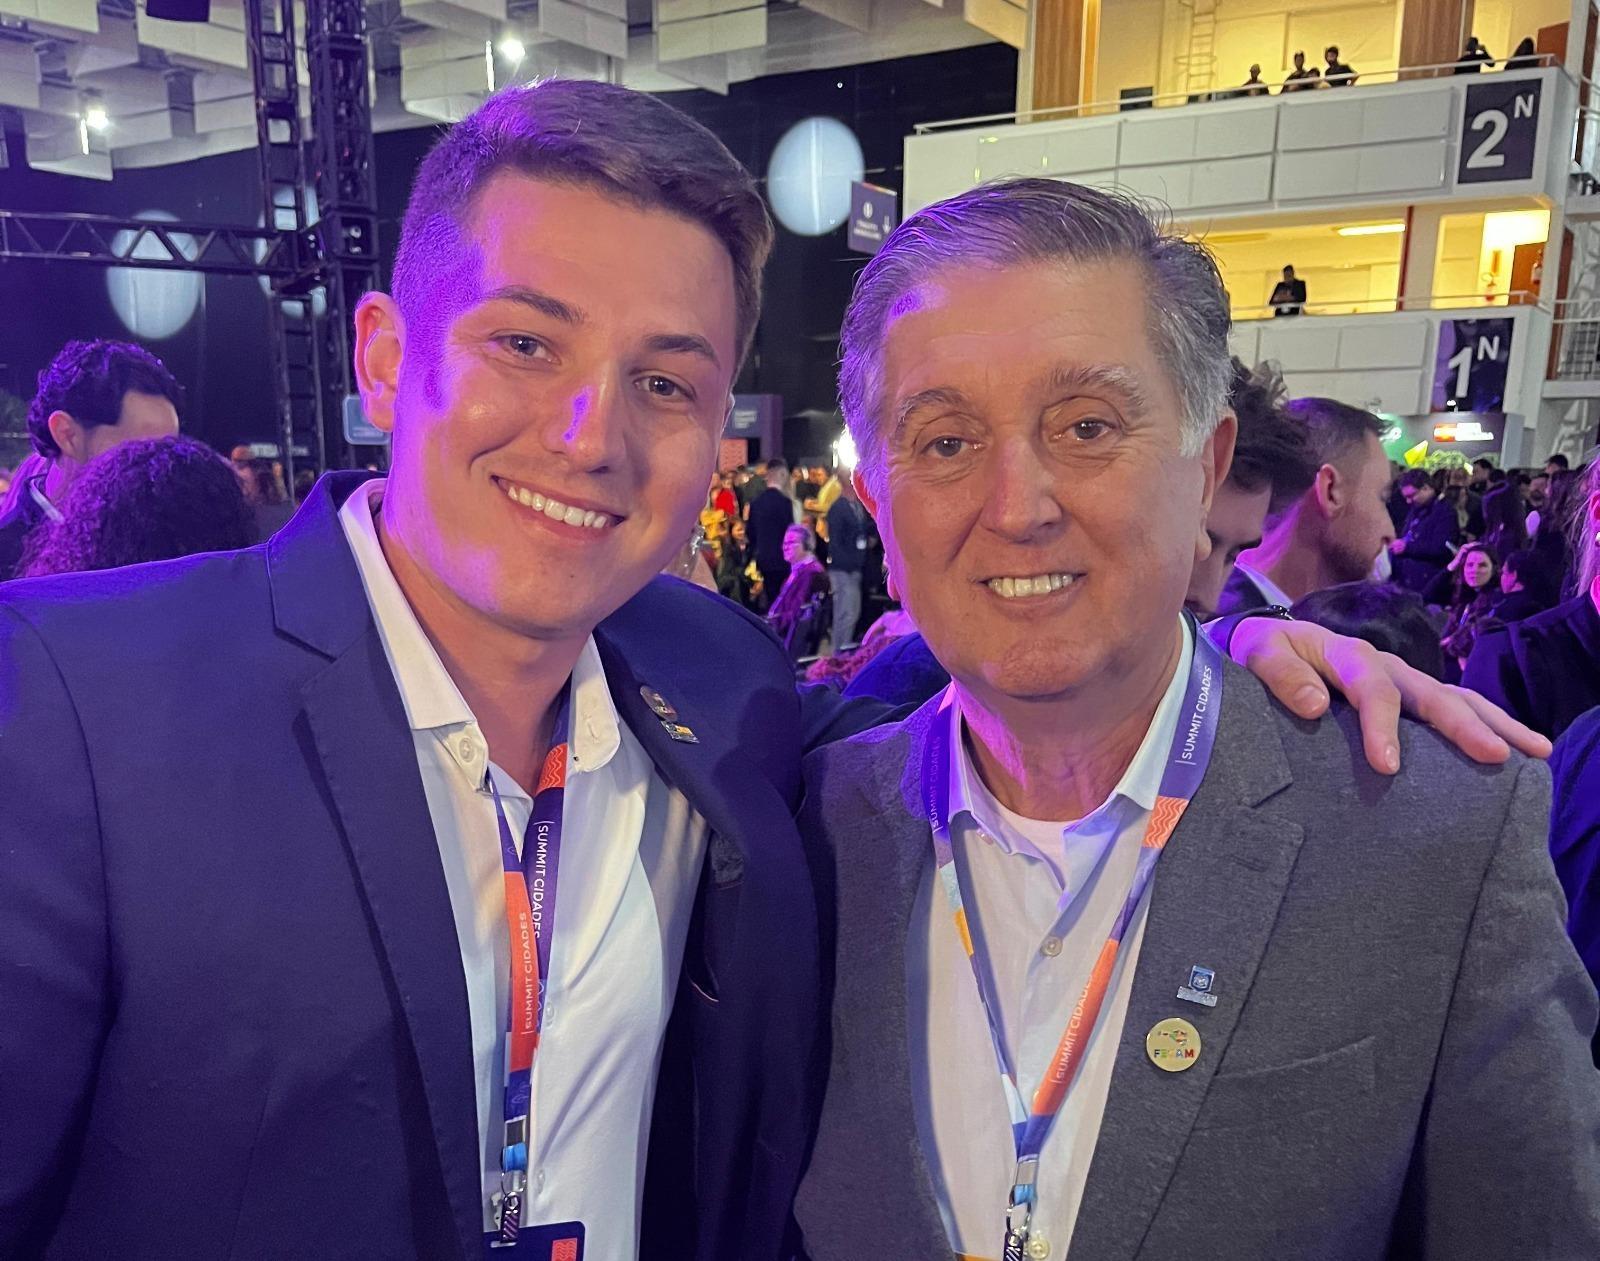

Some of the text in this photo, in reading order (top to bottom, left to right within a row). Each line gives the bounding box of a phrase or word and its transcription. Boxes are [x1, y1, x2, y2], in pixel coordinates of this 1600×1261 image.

[1182, 665, 1212, 760] SUMMIT CIDADES
[535, 825, 549, 877] SUMMIT
[519, 911, 534, 1030] SUMMIT CIDADES
[1056, 974, 1093, 1081] SUMMIT CIDAD
